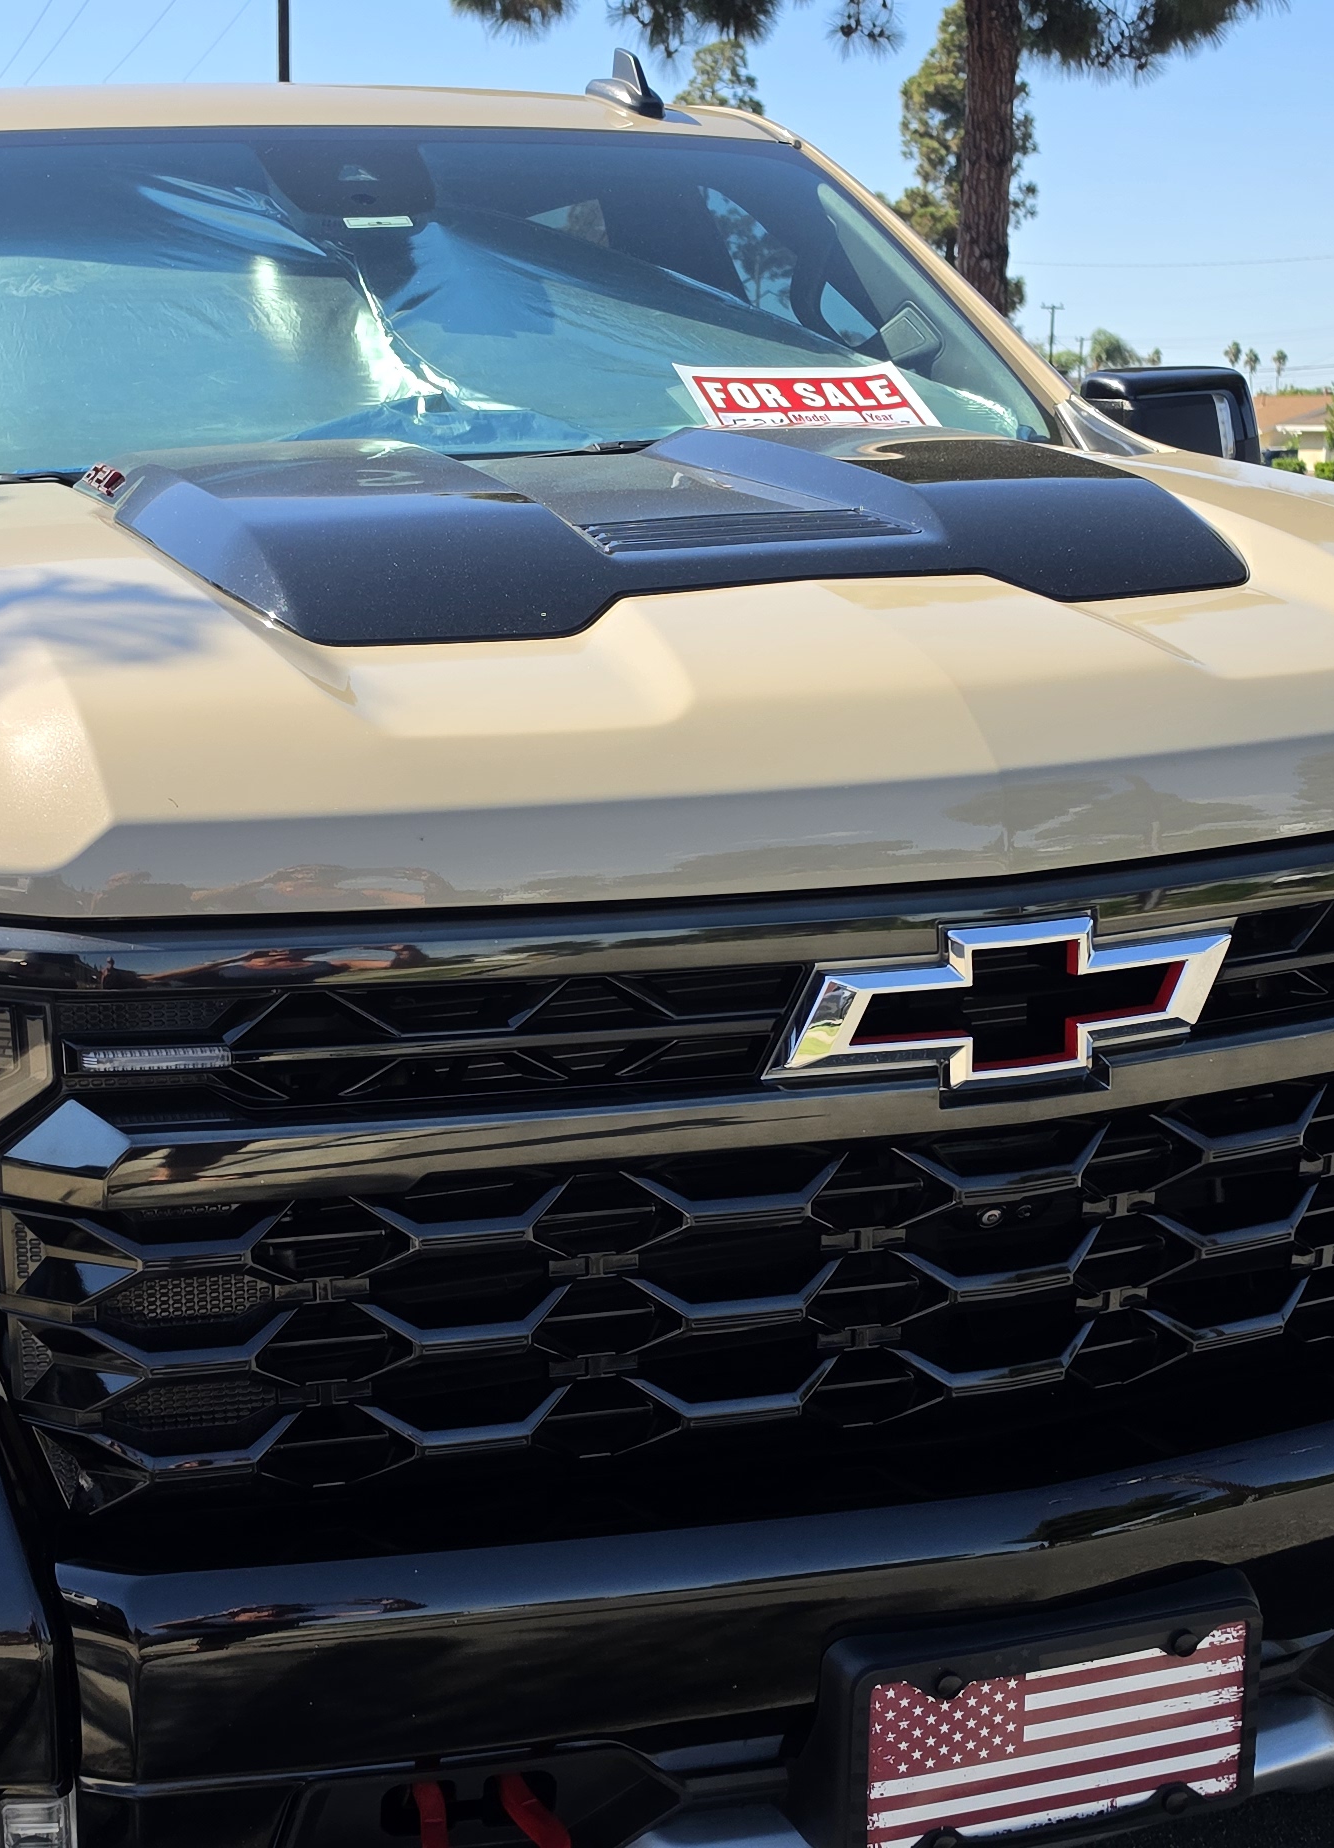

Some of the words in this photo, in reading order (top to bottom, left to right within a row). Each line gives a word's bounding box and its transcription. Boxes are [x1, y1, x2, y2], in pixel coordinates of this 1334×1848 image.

[701, 380, 792, 409] FOR
[792, 377, 902, 408] SALE
[792, 412, 831, 423] Model
[866, 412, 895, 423] Year
